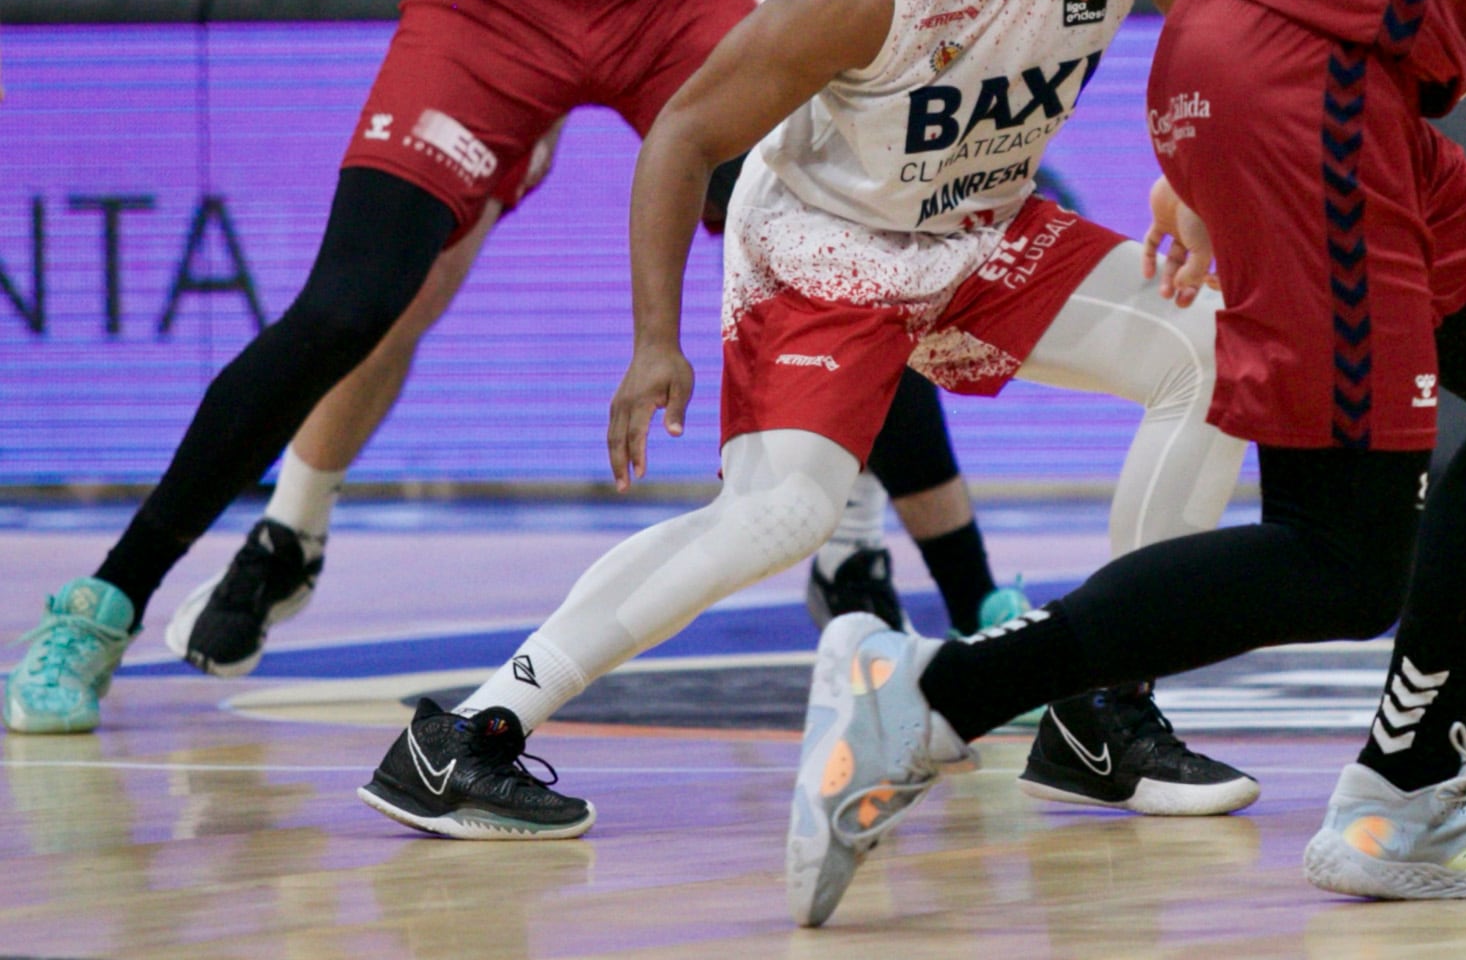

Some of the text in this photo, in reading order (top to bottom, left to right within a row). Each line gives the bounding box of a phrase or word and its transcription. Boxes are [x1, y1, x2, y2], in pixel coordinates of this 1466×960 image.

[1066, 1, 1087, 14] liga
[914, 156, 1032, 228] MANRESA
[978, 235, 1029, 282] ETL
[1003, 218, 1078, 290] GLOBAL
